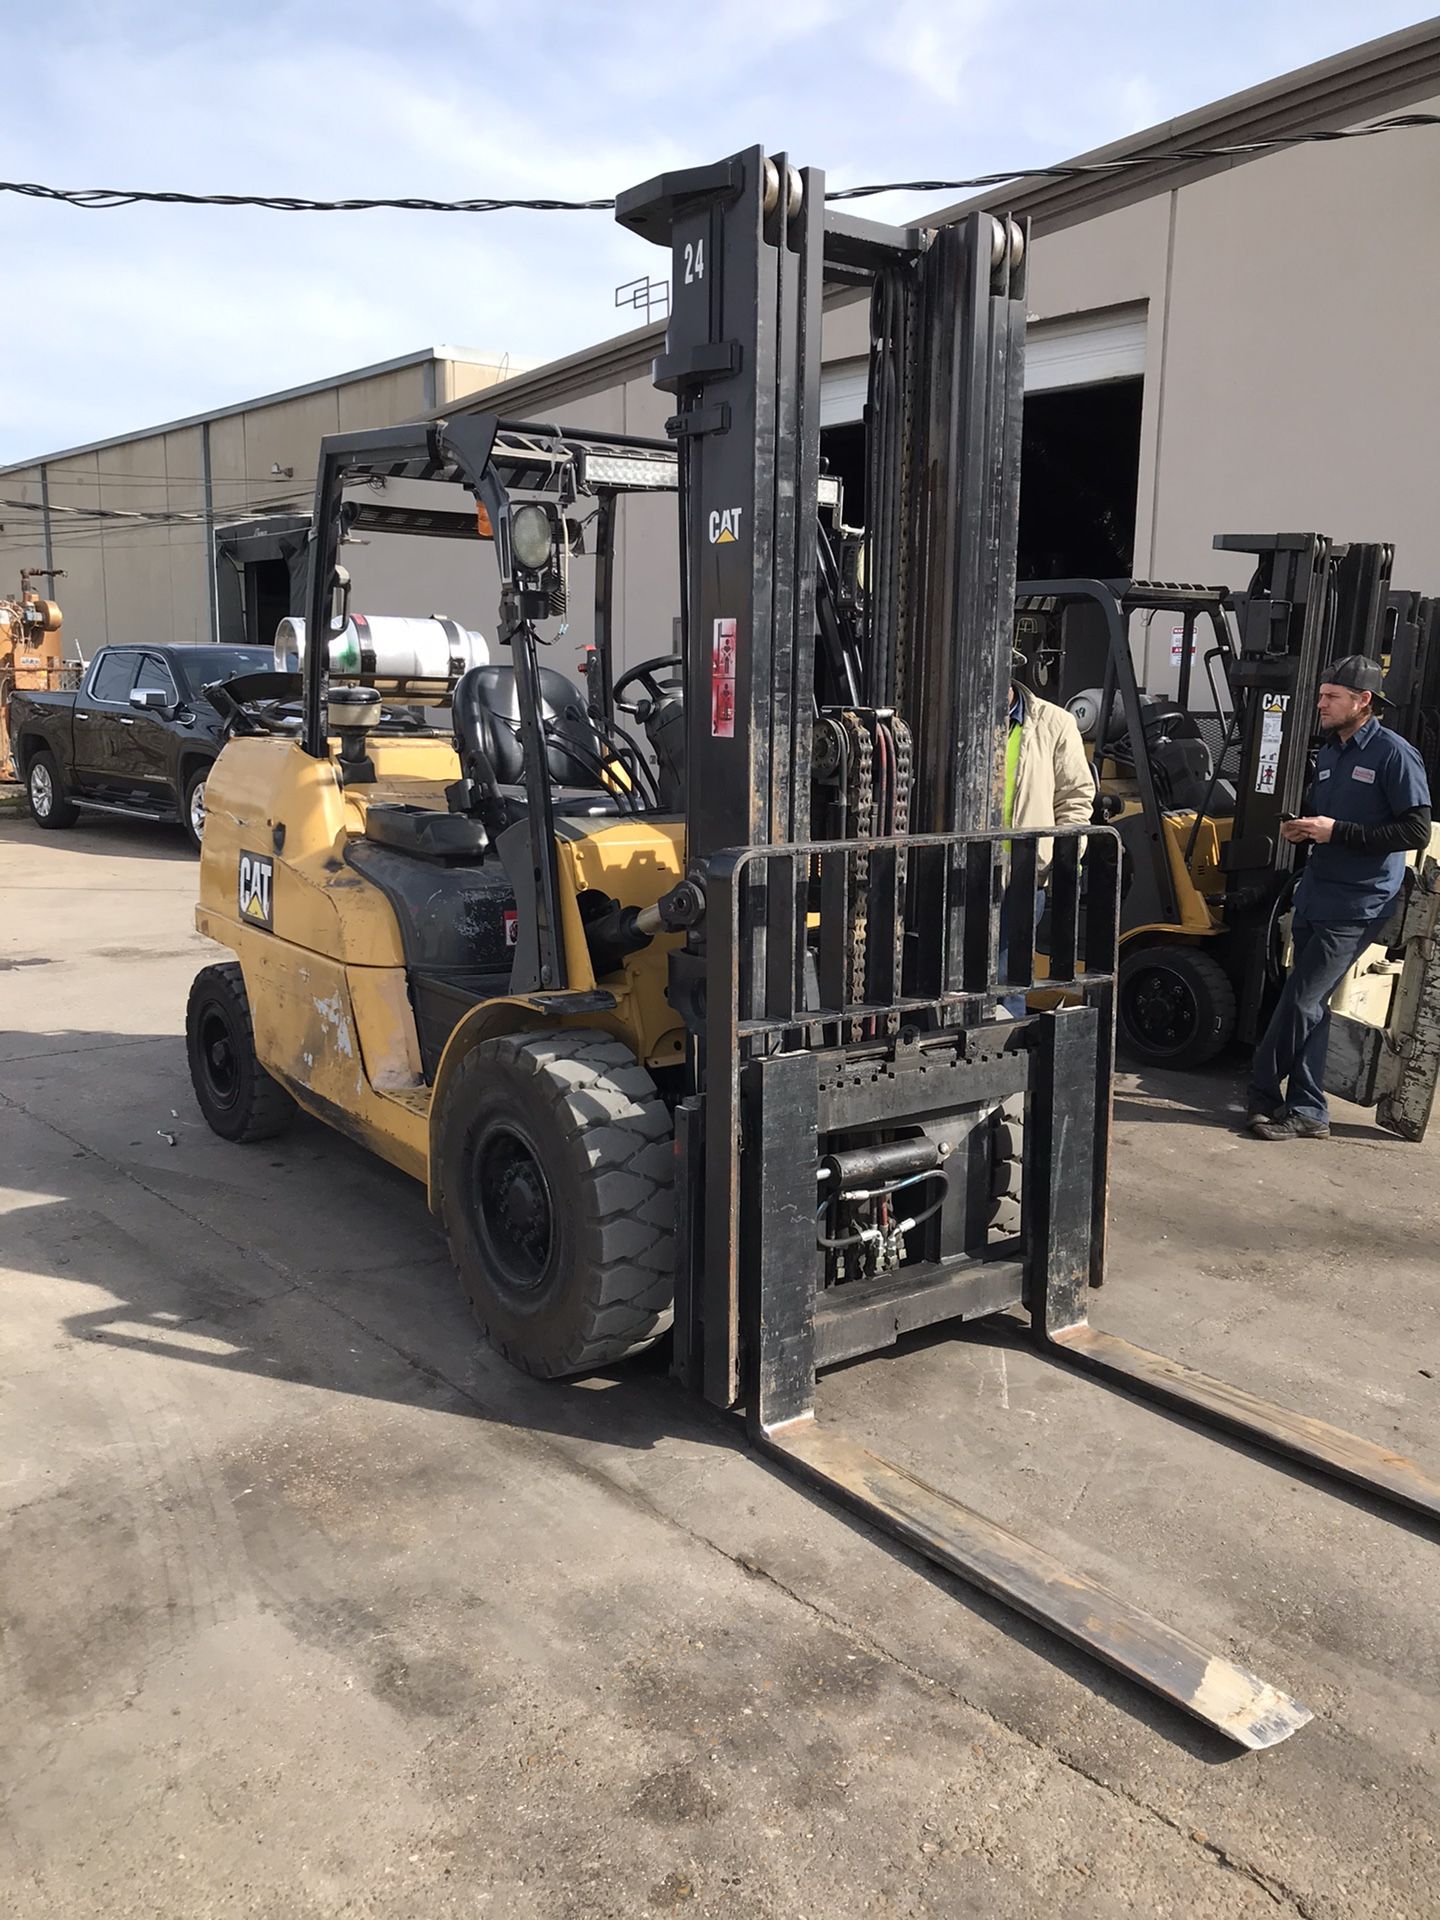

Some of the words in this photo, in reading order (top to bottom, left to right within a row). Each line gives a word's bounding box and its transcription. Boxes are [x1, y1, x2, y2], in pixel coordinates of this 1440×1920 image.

[684, 239, 704, 285] 24
[709, 507, 743, 544] CAT
[1262, 693, 1291, 712] CAT
[240, 857, 272, 920] CAT
